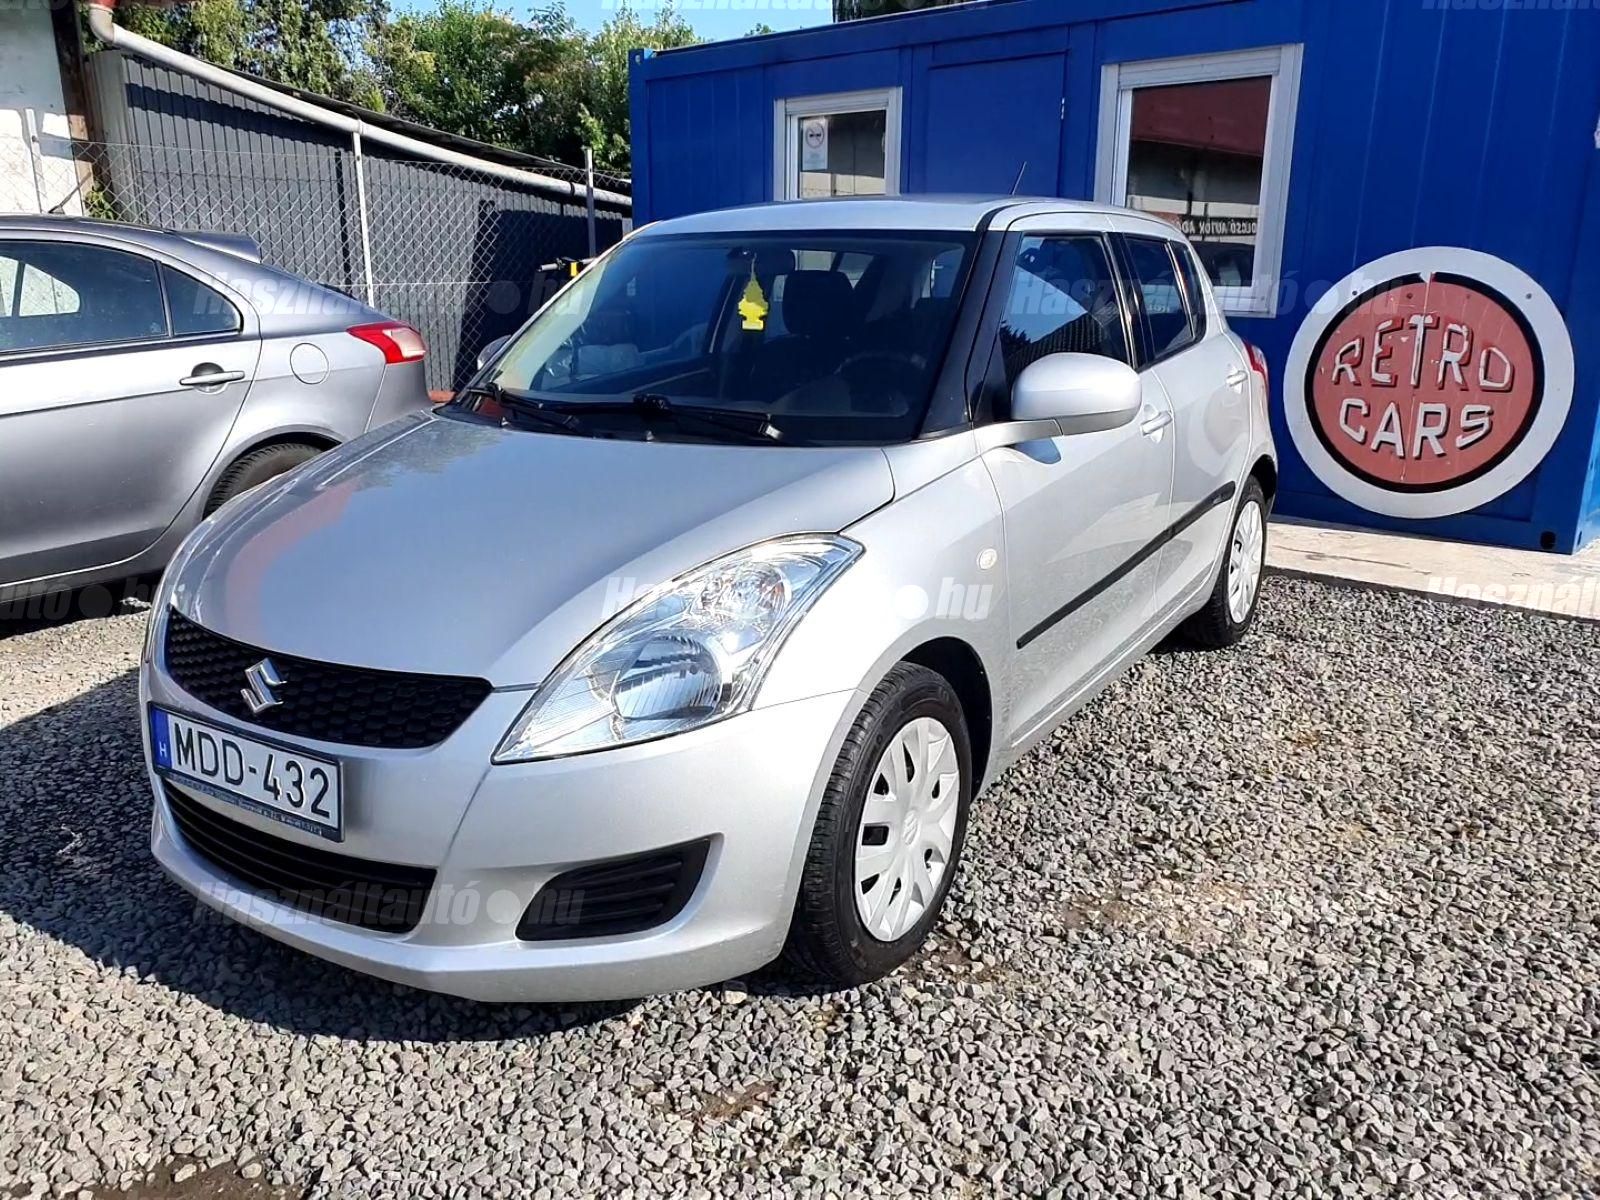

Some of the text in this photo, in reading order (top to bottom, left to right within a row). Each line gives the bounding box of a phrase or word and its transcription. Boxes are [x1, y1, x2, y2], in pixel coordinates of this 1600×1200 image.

[1332, 314, 1514, 391] RETRO
[1339, 398, 1493, 457] CARS
[158, 741, 168, 758] H
[175, 723, 330, 819] MDD-432
